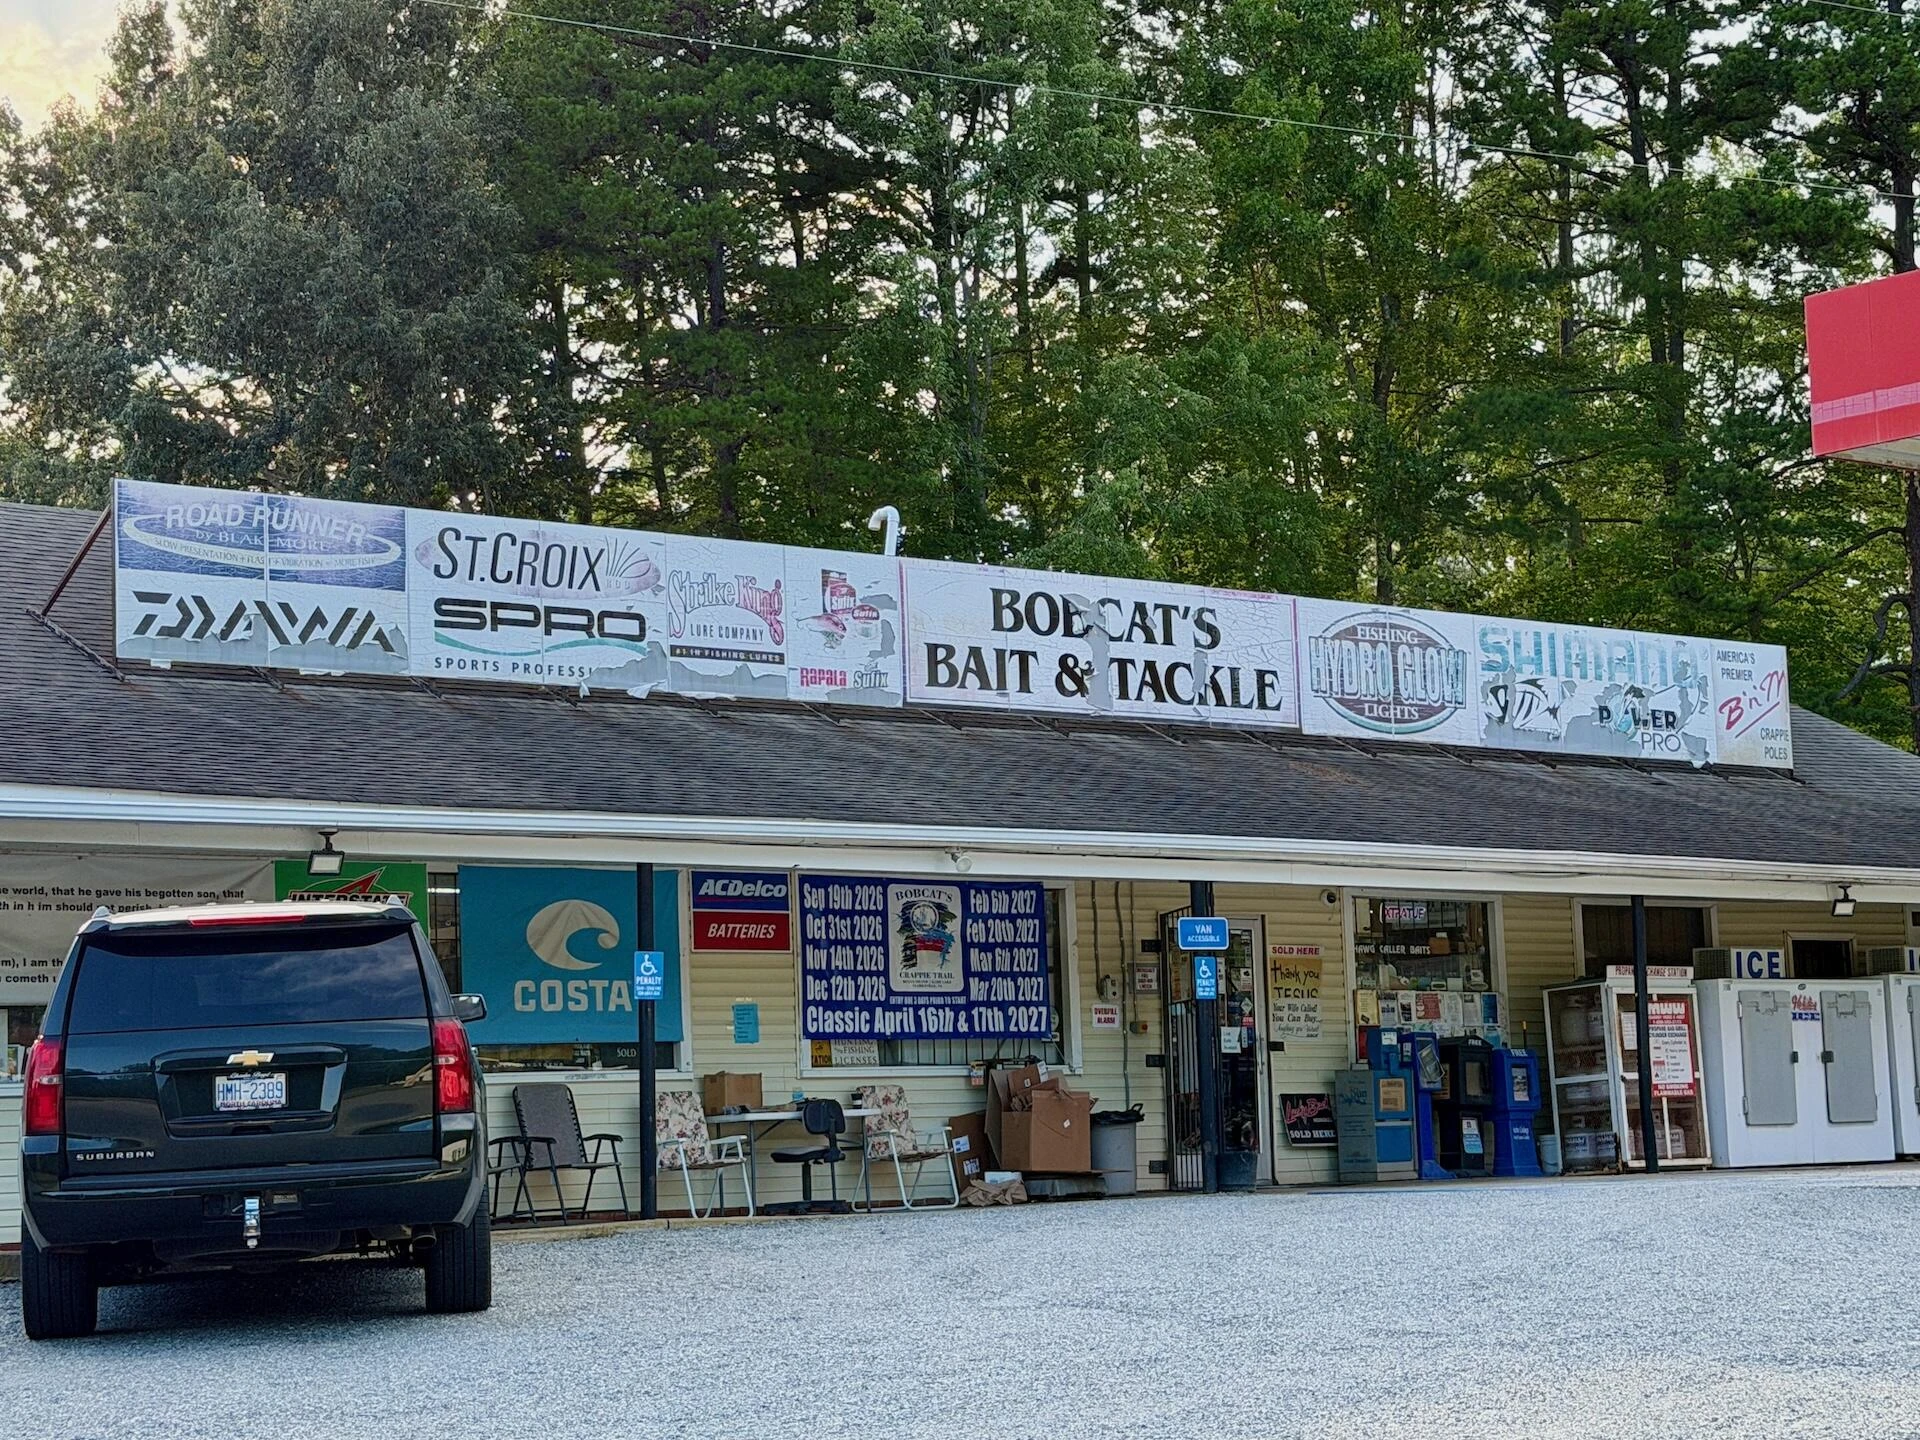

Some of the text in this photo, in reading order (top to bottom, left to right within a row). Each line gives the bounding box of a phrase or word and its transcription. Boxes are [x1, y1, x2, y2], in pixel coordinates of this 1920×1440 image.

[166, 503, 367, 546] ROAD RUNNER
[196, 530, 211, 541] by
[668, 570, 785, 645] Strike King
[433, 597, 647, 642] SPRO
[690, 624, 764, 642] LURE COMPANY
[1356, 626, 1419, 643] FISHING
[705, 649, 746, 660] FISHING
[749, 652, 780, 662] LURES
[1716, 650, 1756, 664] AMERICA'S
[434, 657, 500, 673] SPORTS
[1309, 636, 1467, 709] HYDRO GLOW
[800, 667, 889, 689] Rapala Sufix
[924, 643, 1283, 711] BAIT & TACKLE
[1721, 668, 1753, 681] PREMIER
[1364, 704, 1420, 720] LIGHTS
[1641, 732, 1681, 752] PRO
[1760, 728, 1790, 742] CRAPPIE
[1764, 747, 1788, 761] POLES
[12, 886, 245, 901] world, that he gave his begotten son, that
[698, 879, 787, 898] ACDelco
[895, 888, 954, 903] BOBCAT'S
[803, 883, 884, 912] Sep 19th 2026
[970, 889, 1037, 915] Feb 6th 2027
[13, 901, 25, 911] in
[55, 902, 93, 912] should
[707, 923, 776, 939] BATTERIES
[806, 913, 883, 941] Oct 31st 2026
[966, 918, 1040, 944] Feb 20th 2027
[1194, 925, 1212, 934] VAN
[806, 944, 885, 971] Nov 14th 2026
[1271, 946, 1320, 956] SOLD HERE
[1354, 945, 1432, 955] HAWG CALLER BAITS
[970, 948, 1038, 972] Mar 6th 2027
[1736, 951, 1781, 978] ICE
[5, 974, 49, 983] cometh
[899, 971, 932, 979] CRAPPIE
[1303, 970, 1320, 986] you
[1667, 968, 1688, 977] STATION
[513, 979, 633, 1012] COSTA
[806, 975, 886, 1001] Dec 12th 2026
[969, 977, 1044, 1001] Mar 20th 2027
[806, 1005, 1048, 1036] Classic April 16th & 17th 2027
[1271, 1013, 1284, 1023] You
[1287, 1013, 1302, 1023] Can
[1791, 1012, 1820, 1021] ICE
[843, 1046, 875, 1054] FISHING
[1467, 1039, 1482, 1047] FREE
[616, 1047, 637, 1058] SOLD
[1510, 1049, 1528, 1057] FREE
[834, 1056, 877, 1066] LICENSES
[217, 1080, 283, 1101] HMH-2389
[1289, 1129, 1336, 1139] SOLD HERE
[76, 1150, 155, 1161] SUBURBAN
